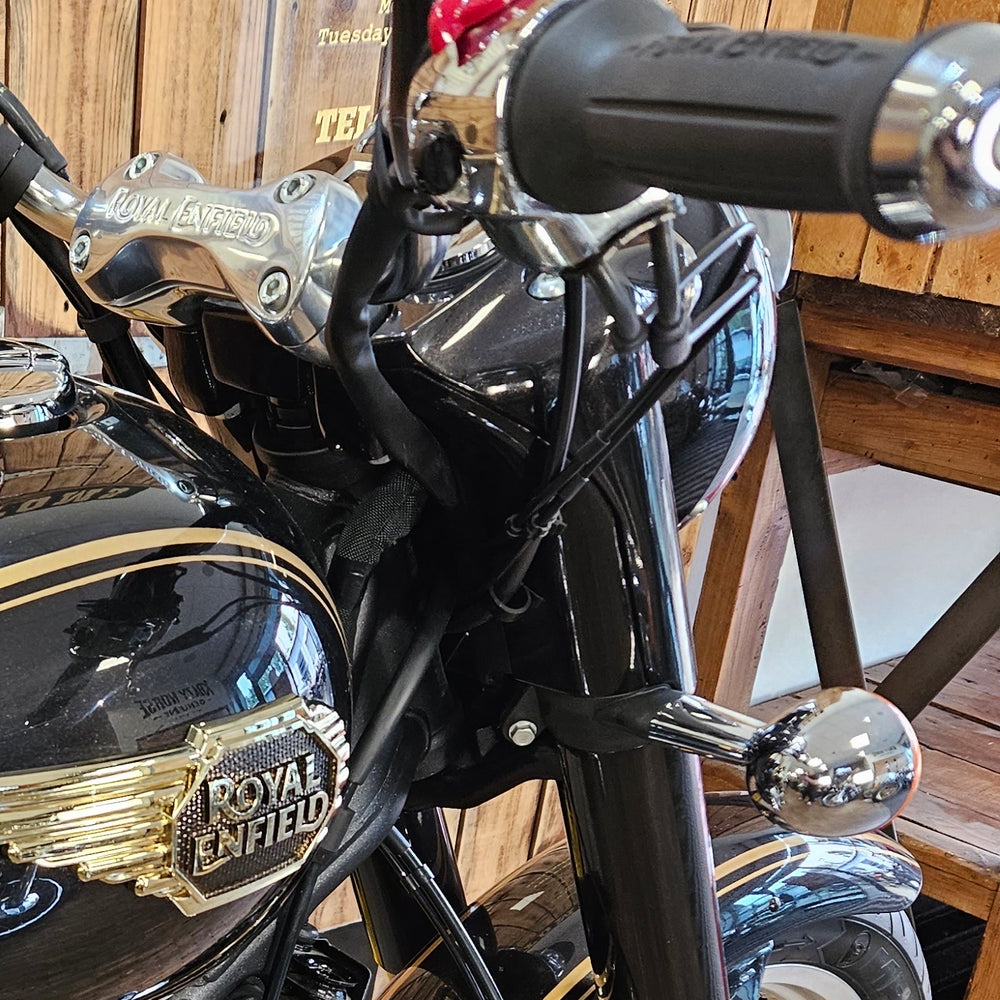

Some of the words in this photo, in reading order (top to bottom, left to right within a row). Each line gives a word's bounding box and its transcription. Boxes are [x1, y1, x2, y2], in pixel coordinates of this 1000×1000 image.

[318, 23, 393, 47] Tuesday
[105, 186, 169, 225] ROYAL
[170, 194, 280, 247] ENFIELD
[209, 753, 321, 825] ROYAL
[192, 790, 330, 877] ENFIELD
